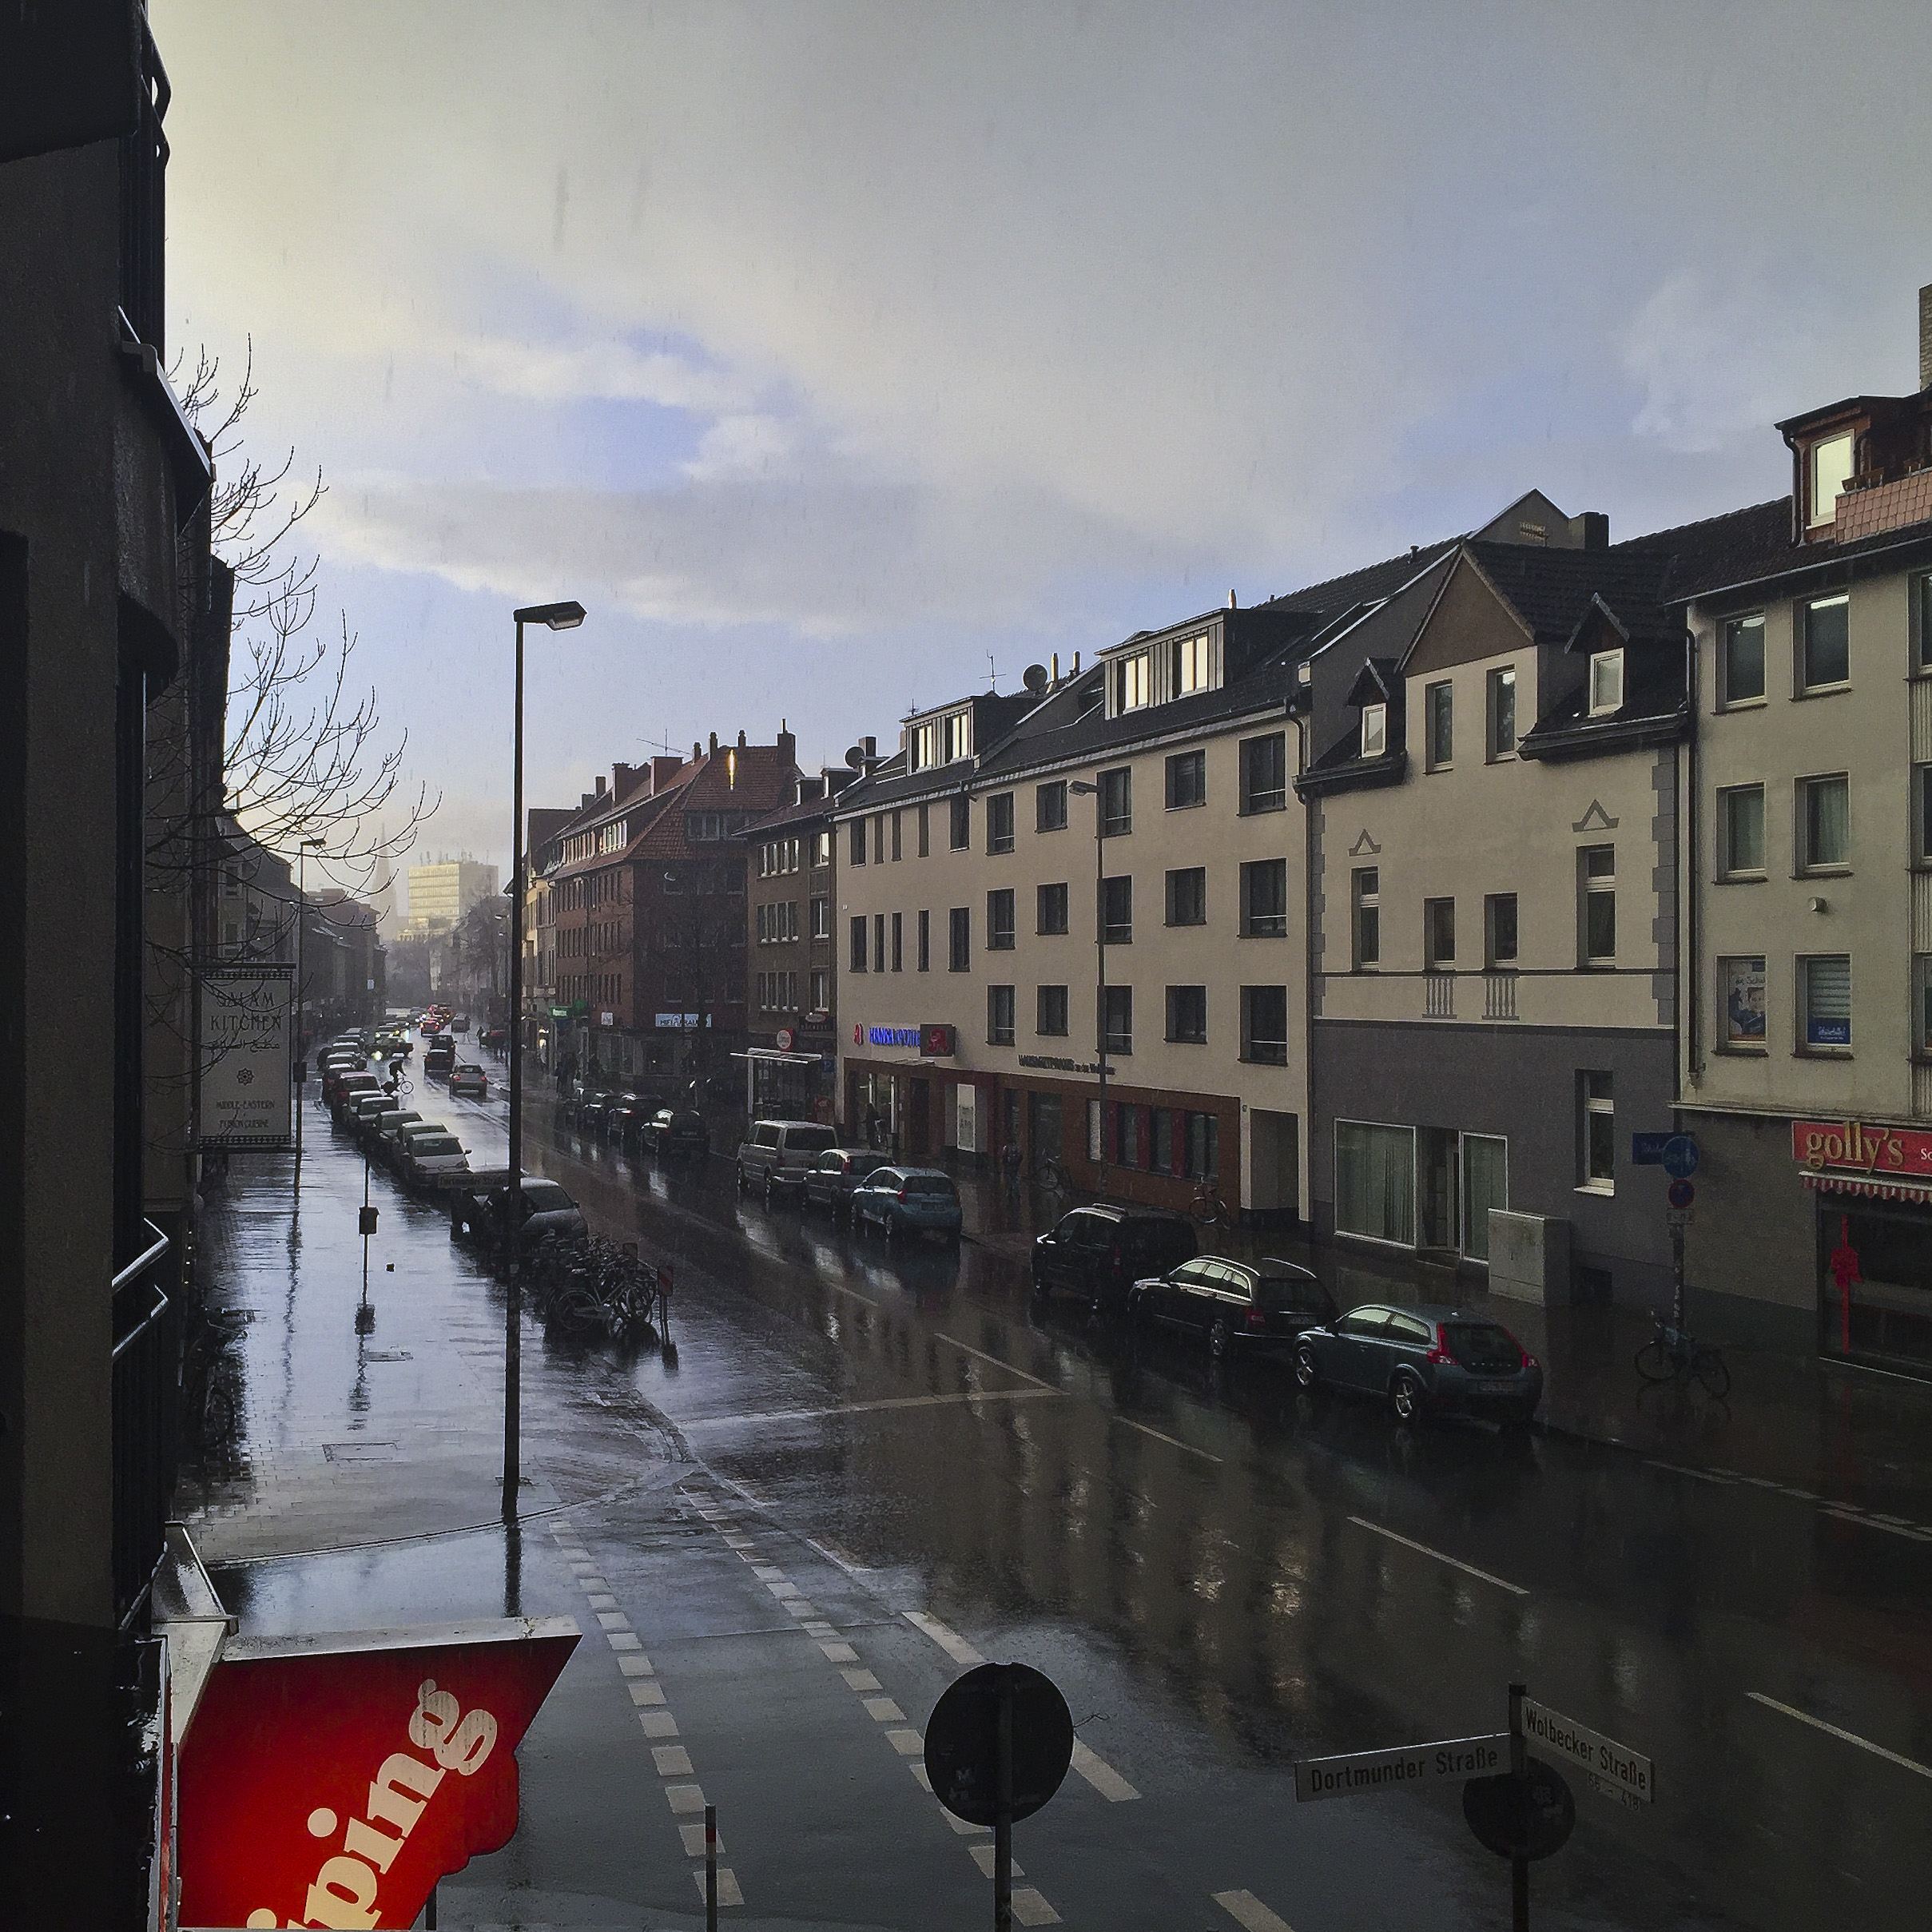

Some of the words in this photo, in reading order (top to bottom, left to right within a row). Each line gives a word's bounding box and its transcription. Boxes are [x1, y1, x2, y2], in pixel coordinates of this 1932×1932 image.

[216, 991, 275, 1008] SALAM
[210, 1016, 282, 1031] KITCHEN
[1806, 1120, 1905, 1175] golly's
[1310, 1757, 1425, 1792] Dortmunder
[1436, 1746, 1498, 1775] Straße
[1525, 1706, 1593, 1762] Wolbecker
[1599, 1745, 1646, 1790] Straße
